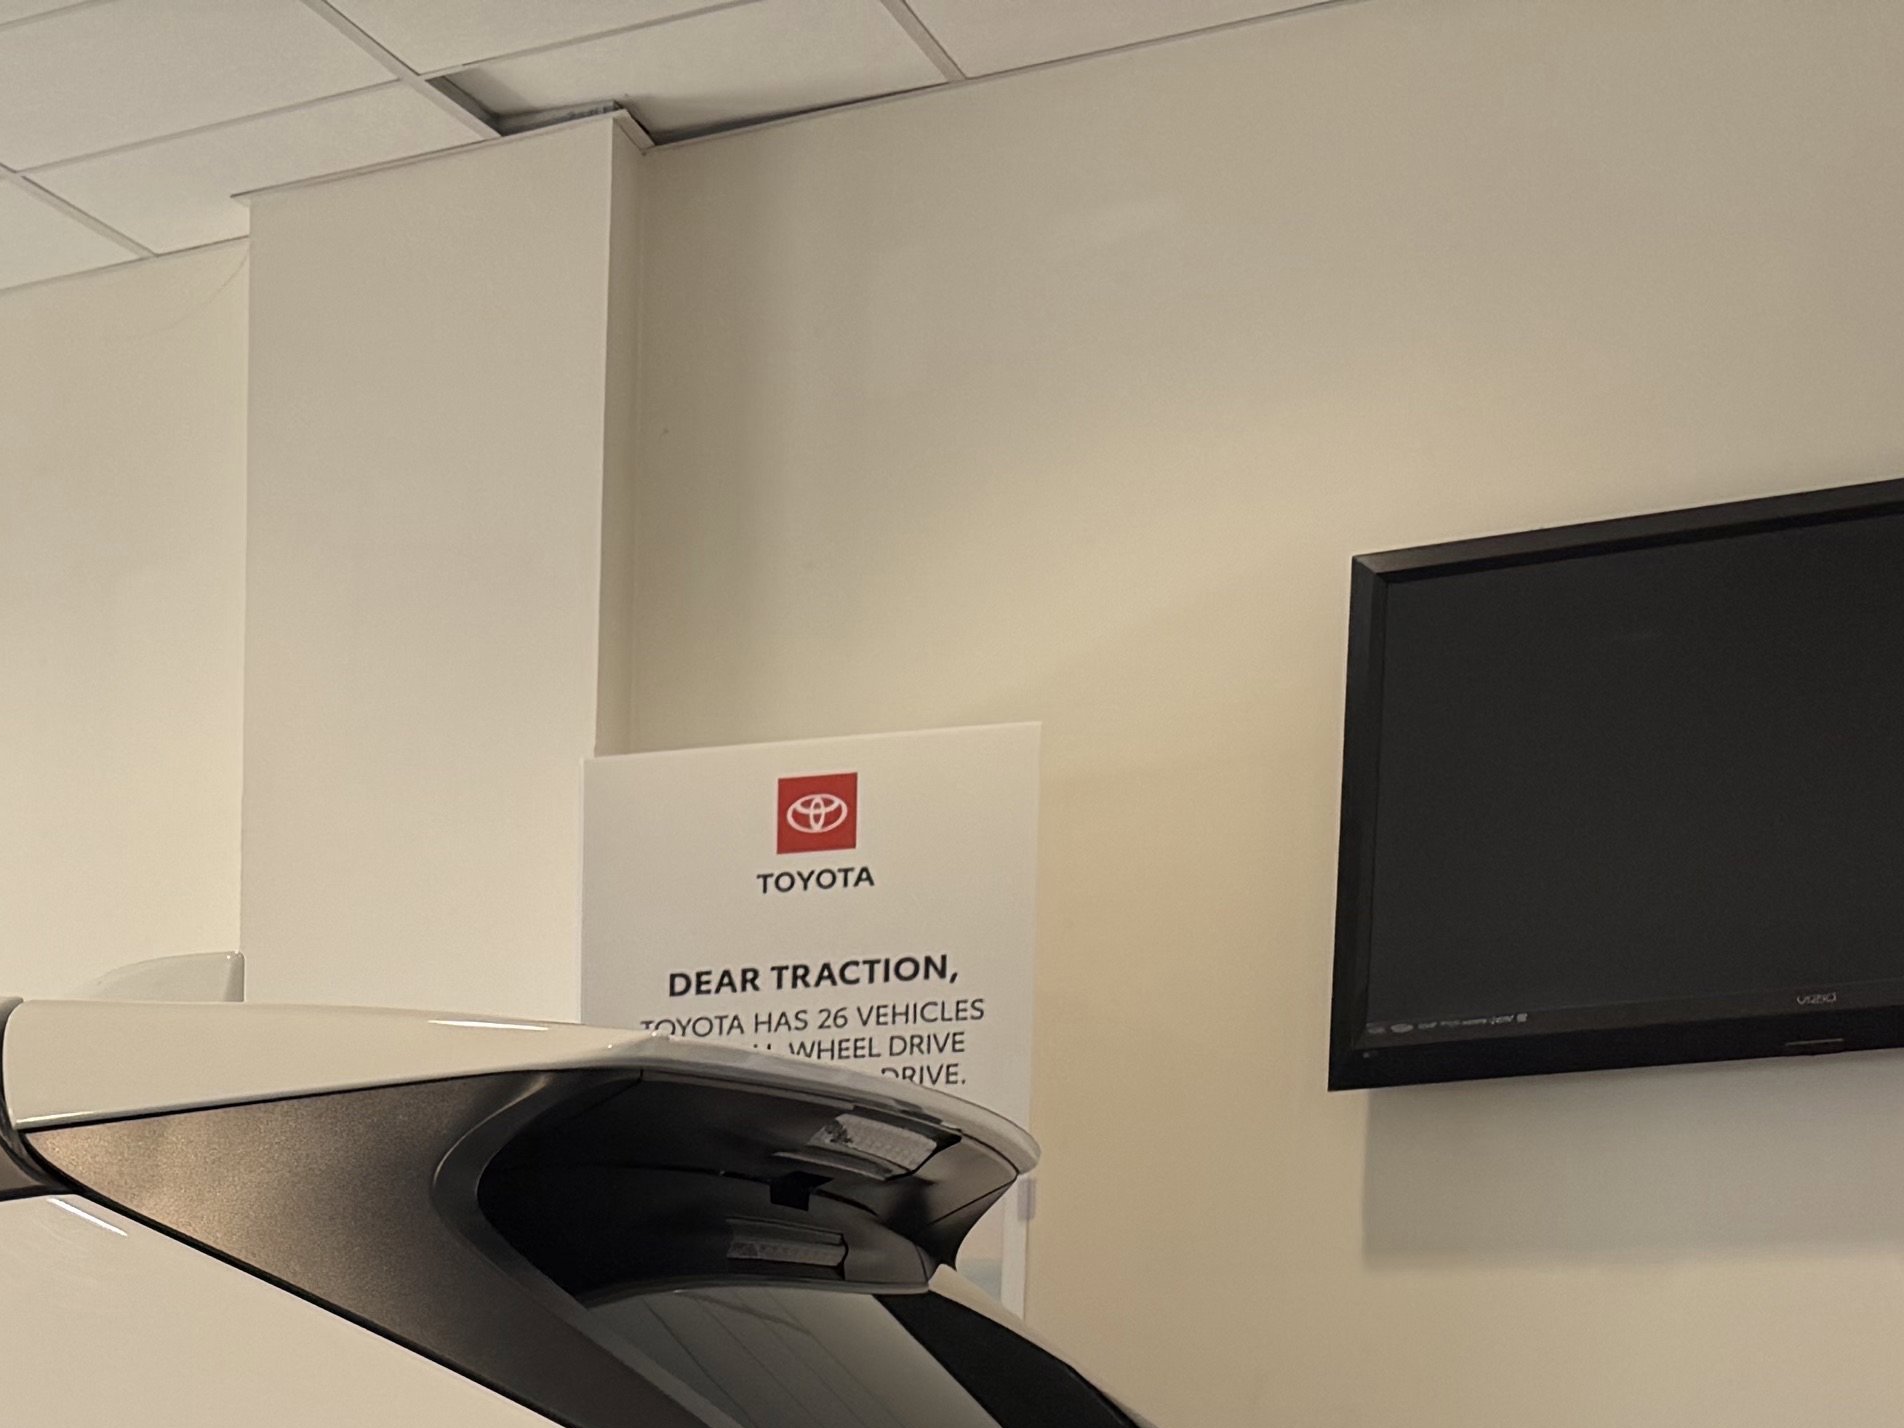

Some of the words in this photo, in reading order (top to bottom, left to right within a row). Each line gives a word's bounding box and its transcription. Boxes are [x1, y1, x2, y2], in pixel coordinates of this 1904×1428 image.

[757, 866, 875, 894] TOYOTA
[668, 966, 761, 998] DEAR
[771, 953, 959, 990] TRACTION,
[753, 1009, 809, 1034] HAS
[818, 1007, 849, 1030] 26
[856, 998, 986, 1027] VEHICLES
[889, 1031, 966, 1056] DRIVE
